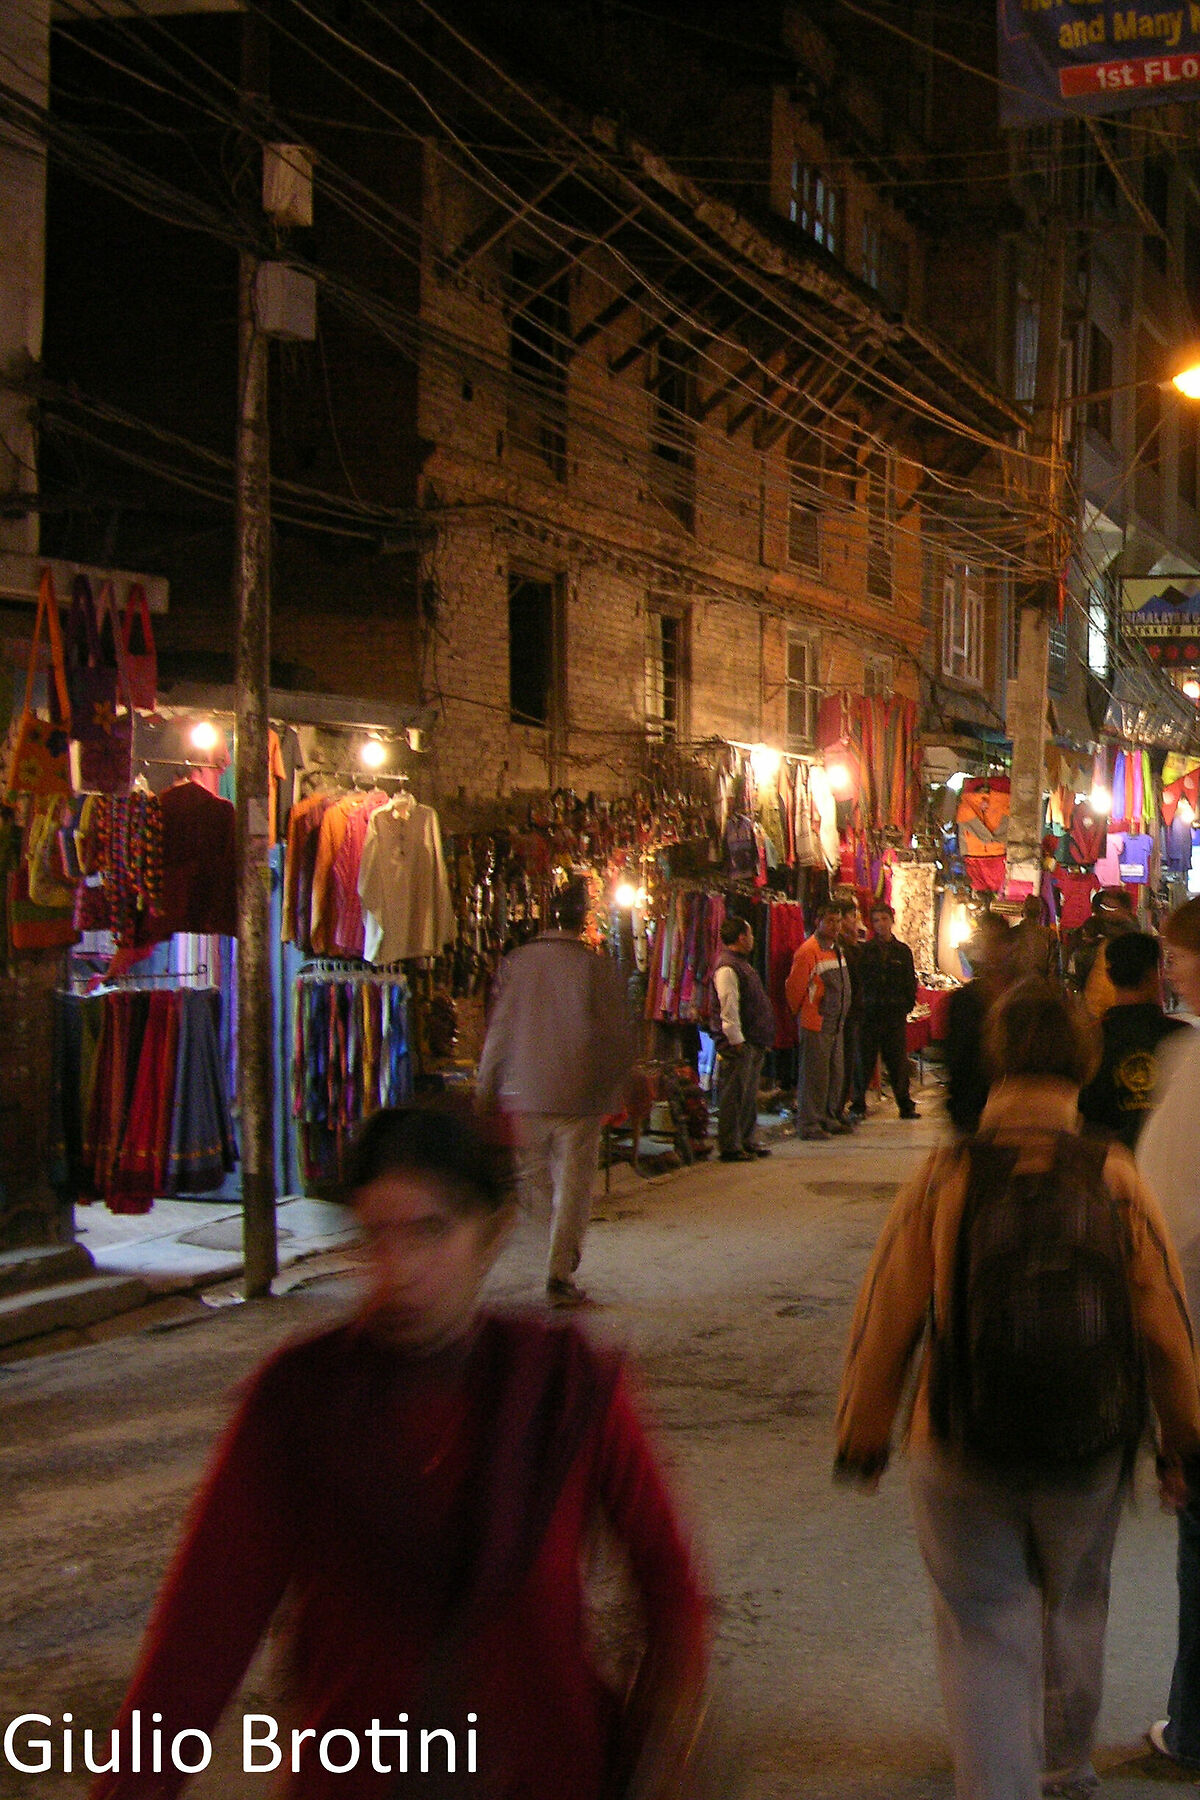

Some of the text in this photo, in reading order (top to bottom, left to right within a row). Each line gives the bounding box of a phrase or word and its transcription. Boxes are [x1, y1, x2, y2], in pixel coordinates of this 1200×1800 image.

[1058, 14, 1105, 49] and
[1113, 9, 1185, 46] Many
[1096, 65, 1135, 88] 1st
